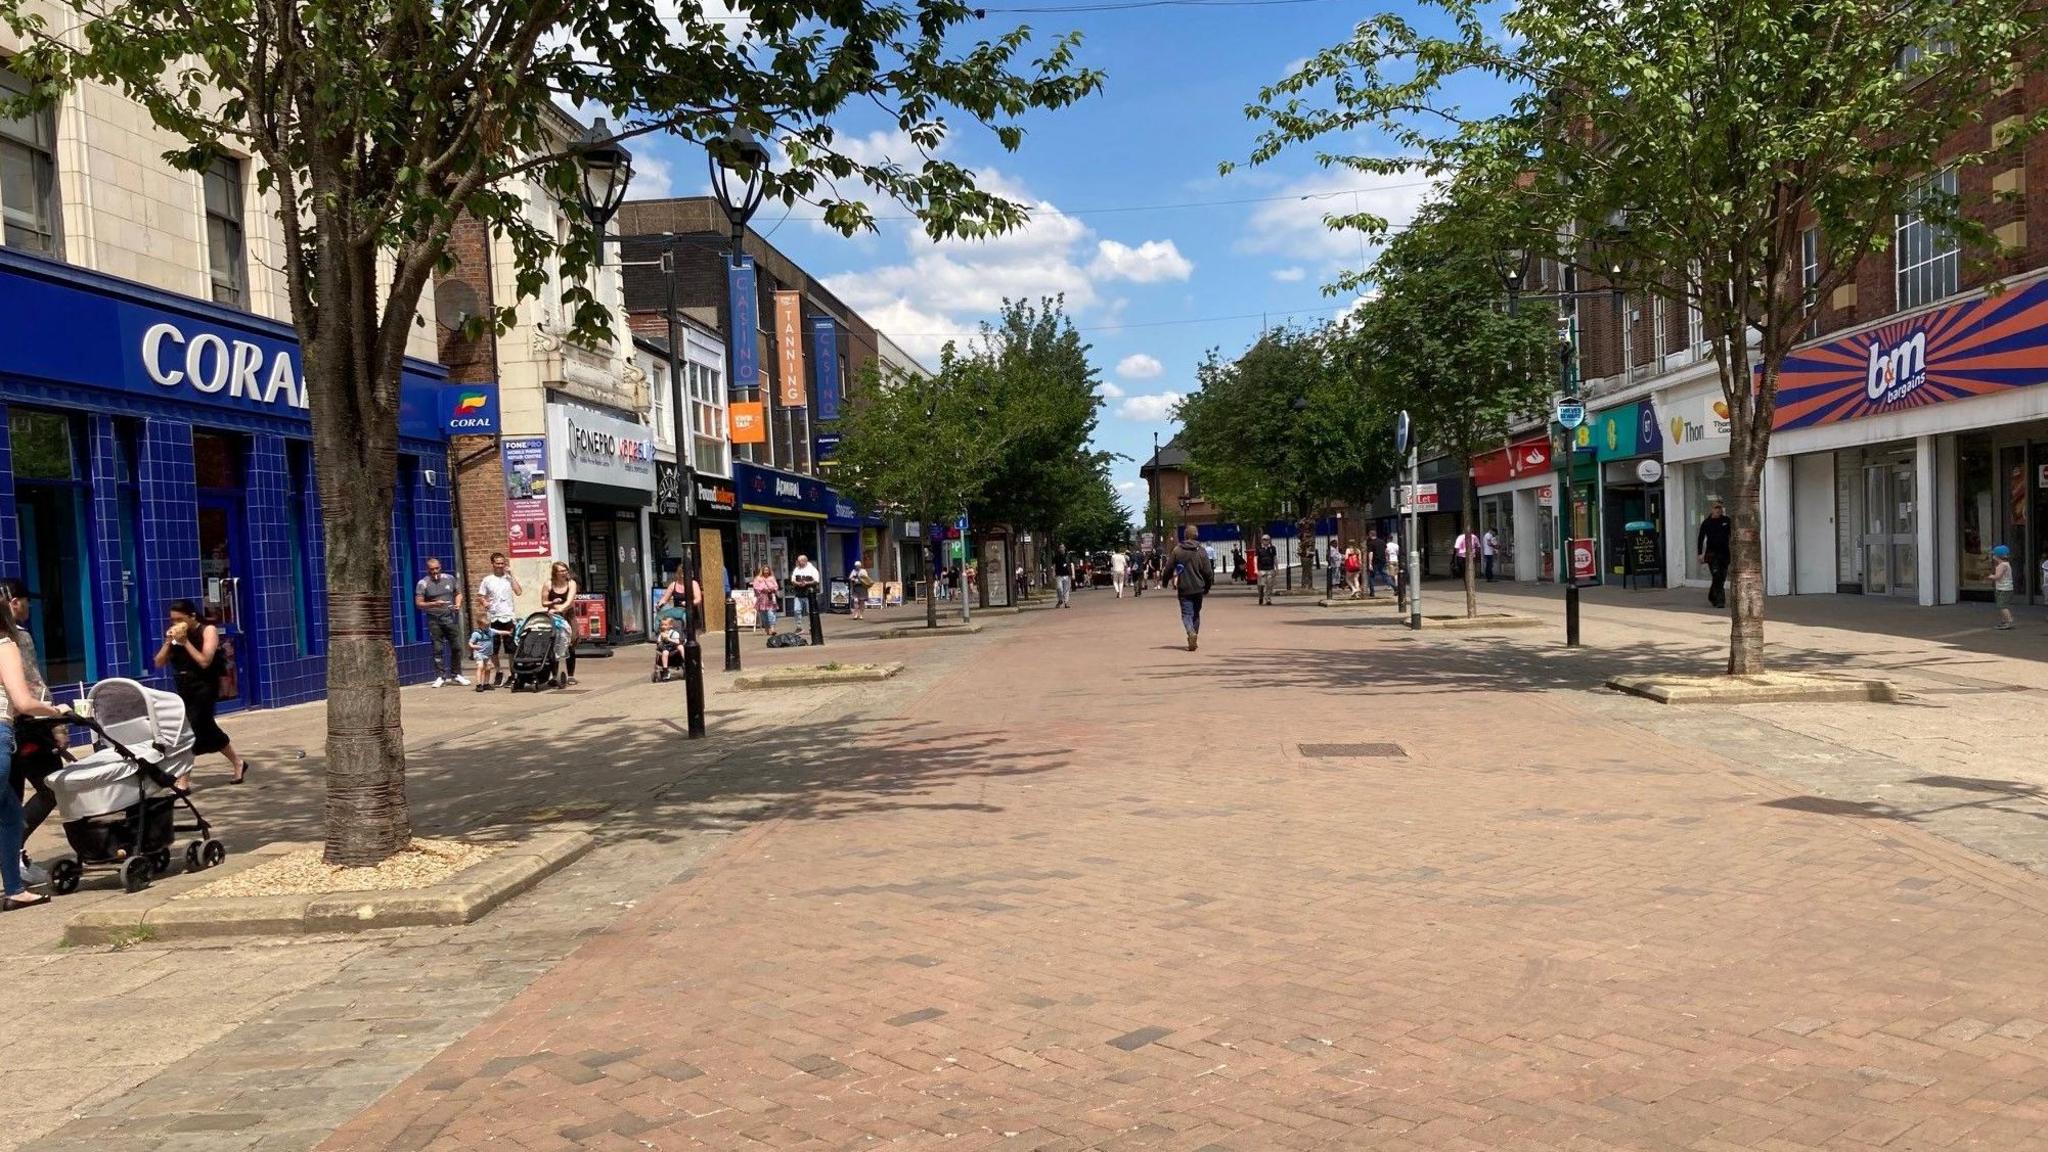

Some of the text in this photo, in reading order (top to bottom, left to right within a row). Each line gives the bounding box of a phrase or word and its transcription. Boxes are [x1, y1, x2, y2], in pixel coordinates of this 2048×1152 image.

[736, 277, 752, 378] CASINO
[785, 311, 798, 400] TANNING
[142, 323, 309, 409] CORA
[820, 333, 834, 414] CASINO
[1887, 372, 1926, 403] bargains
[450, 418, 491, 428] CORAL
[575, 427, 615, 456] FONEPRO
[1417, 495, 1431, 503] Let
